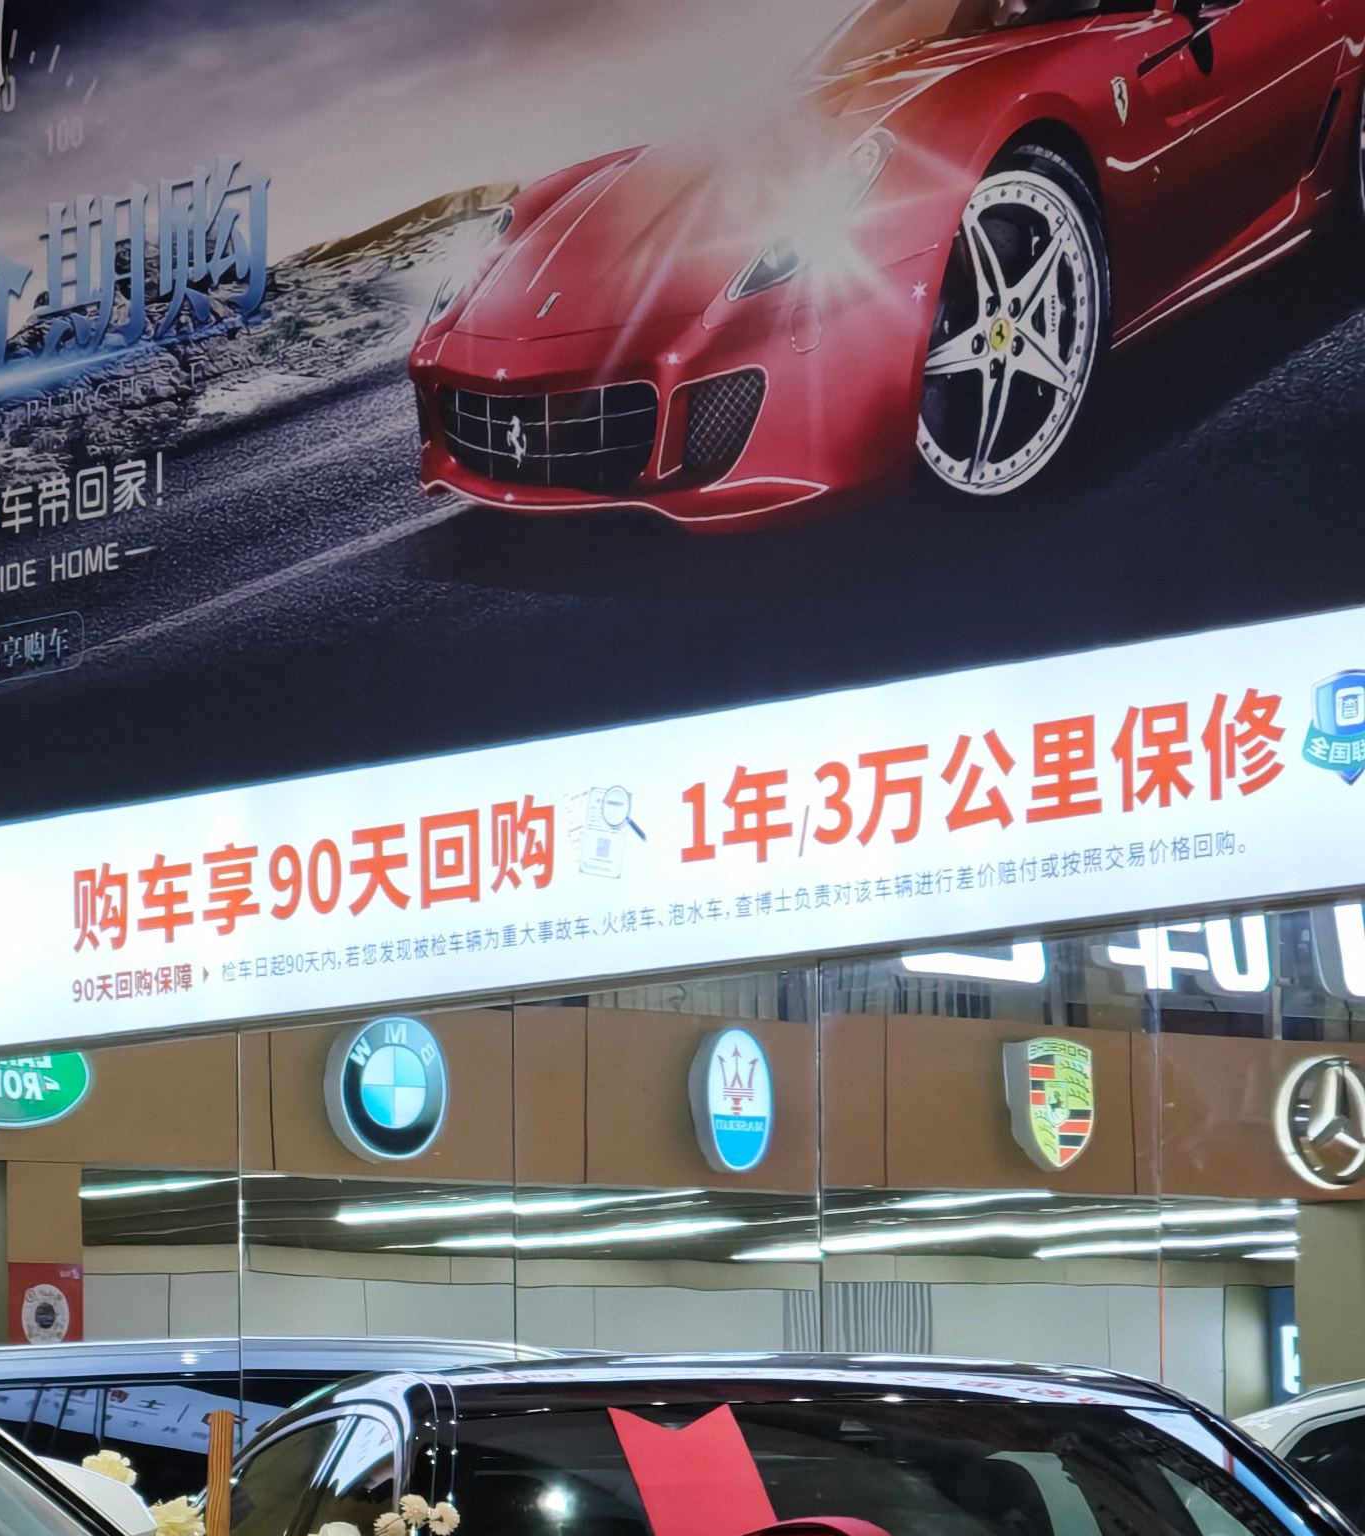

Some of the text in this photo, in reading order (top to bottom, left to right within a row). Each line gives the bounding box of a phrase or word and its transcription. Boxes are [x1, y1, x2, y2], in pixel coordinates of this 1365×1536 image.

[51, 542, 119, 582] HOME
[73, 795, 555, 953] 购车享90天回购
[73, 963, 194, 1003] 90天回购保障
